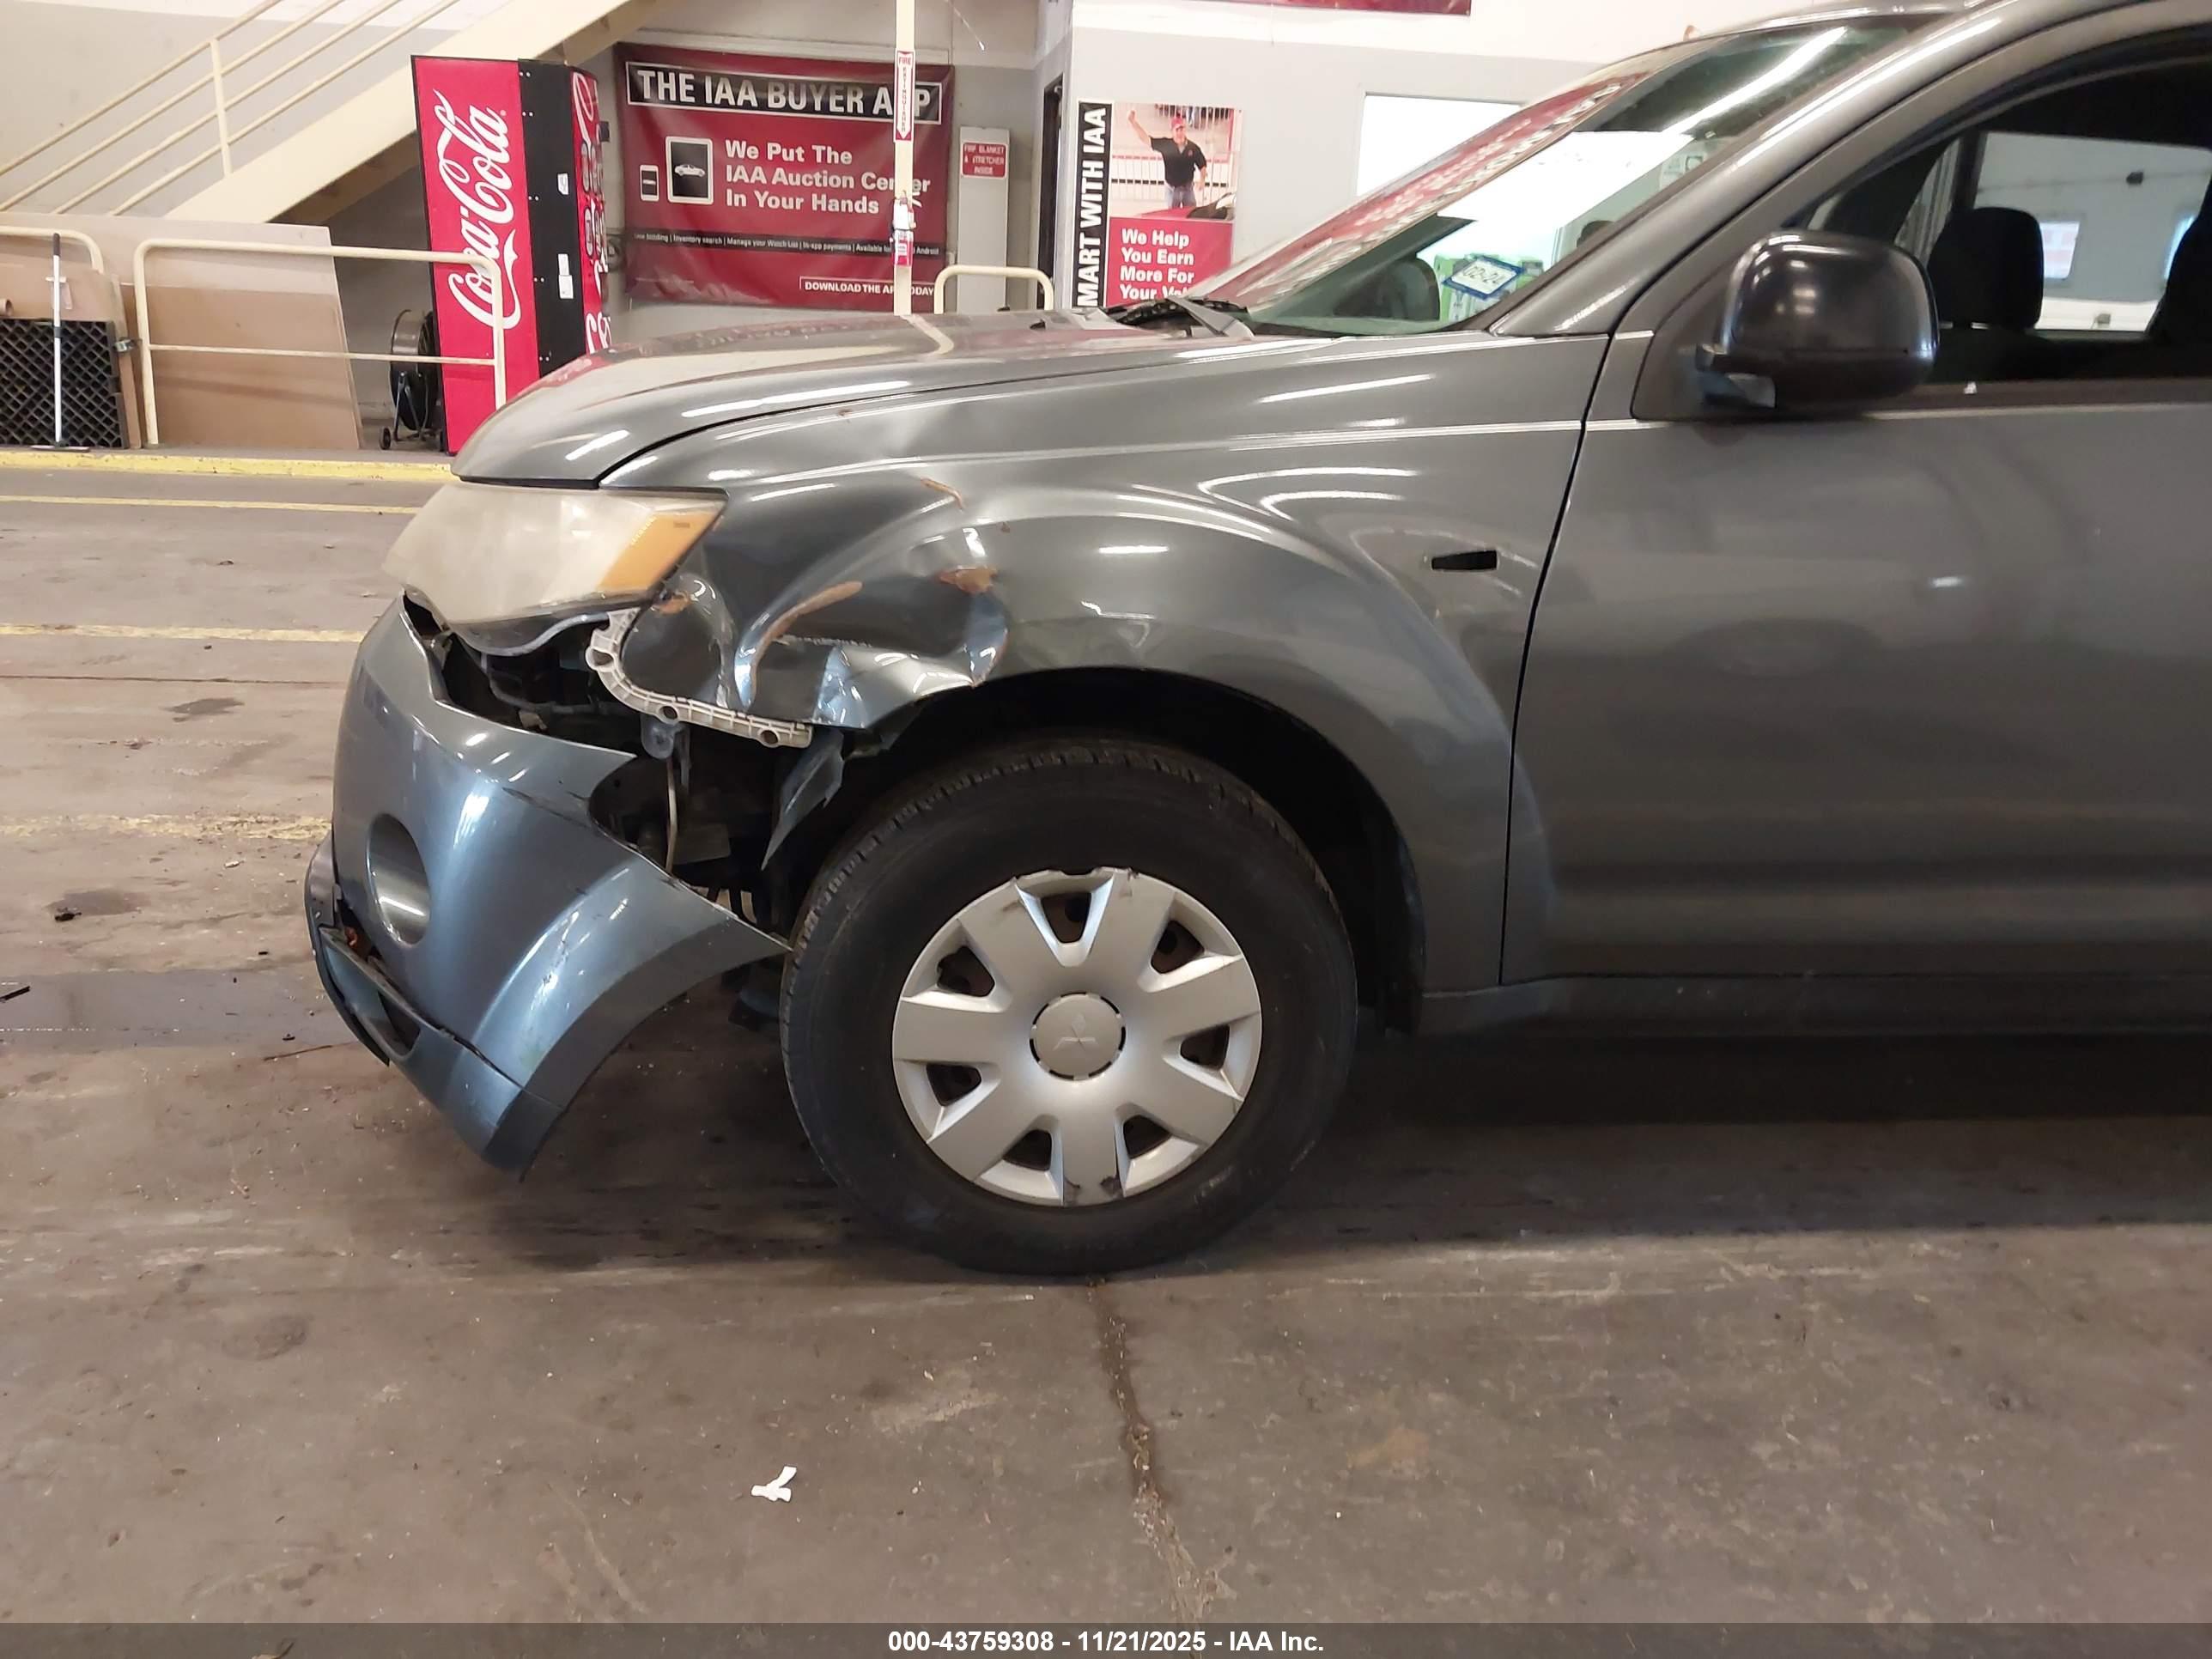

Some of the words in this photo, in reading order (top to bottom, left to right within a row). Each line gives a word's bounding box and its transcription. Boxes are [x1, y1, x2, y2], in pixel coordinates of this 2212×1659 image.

[898, 57, 911, 65] FIRE
[637, 70, 696, 103] THE
[704, 75, 758, 107] IAA
[767, 82, 864, 114] BUYER
[872, 87, 931, 117] AP
[1083, 107, 1106, 153] IAA
[725, 139, 759, 159] We
[767, 142, 805, 162] Put
[811, 144, 853, 164] The
[726, 164, 767, 185] IAA
[771, 167, 854, 189] Auction
[861, 172, 931, 193] Cener
[726, 188, 747, 207] In
[754, 190, 804, 210] Your
[811, 193, 879, 214] Hands
[1080, 160, 1104, 228] WITH
[673, 233, 701, 245] Inventory
[726, 237, 751, 247] Manage
[855, 243, 883, 252] Available
[1121, 228, 1147, 245] We
[1152, 229, 1190, 250] Help
[1121, 246, 1152, 264] You
[1157, 248, 1194, 265] Earn
[1120, 264, 1163, 283] More
[1168, 267, 1195, 284] For
[805, 281, 860, 293] DOWNLOAD
[863, 283, 880, 293] THE
[910, 285, 934, 296] ODAY
[1119, 283, 1158, 300] Your
